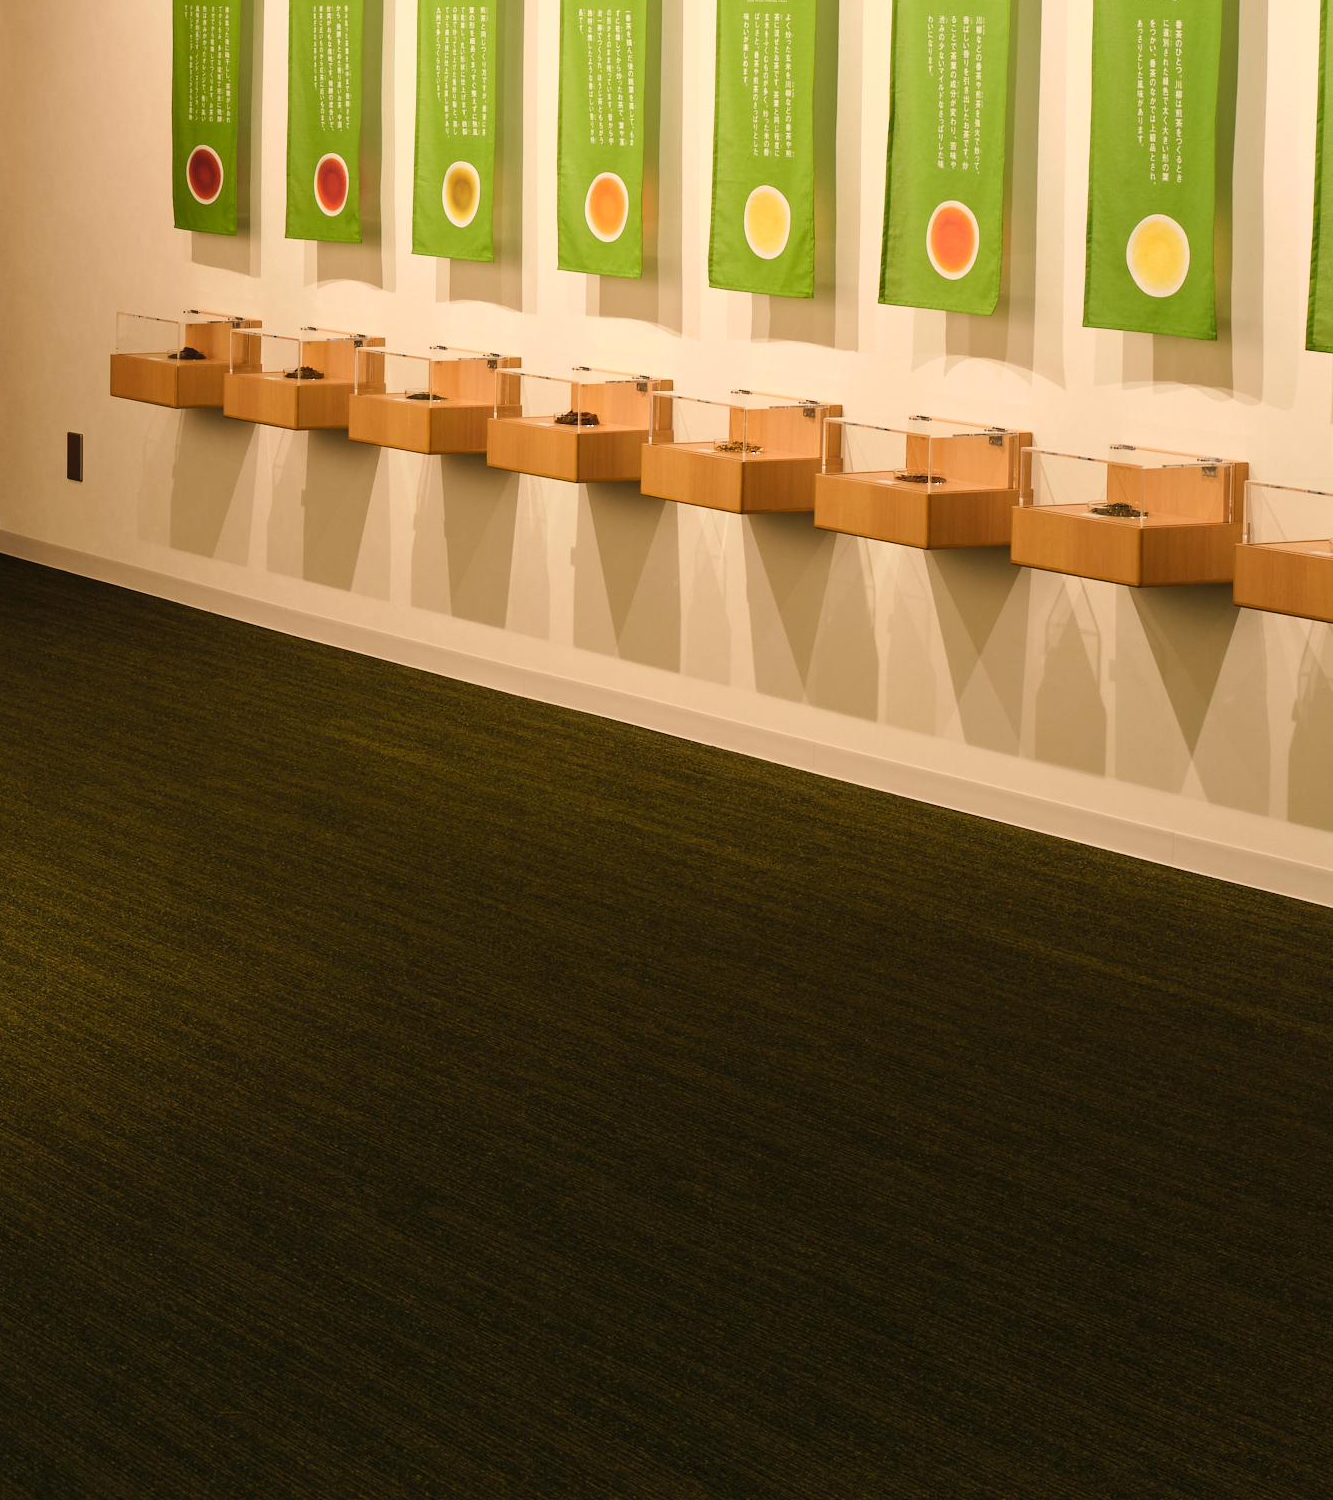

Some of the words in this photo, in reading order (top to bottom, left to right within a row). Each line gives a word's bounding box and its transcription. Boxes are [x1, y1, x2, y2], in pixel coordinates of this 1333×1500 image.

[1175, 19, 1183, 183] 番茶のひとつ。川柳は煎茶をつくるとき
